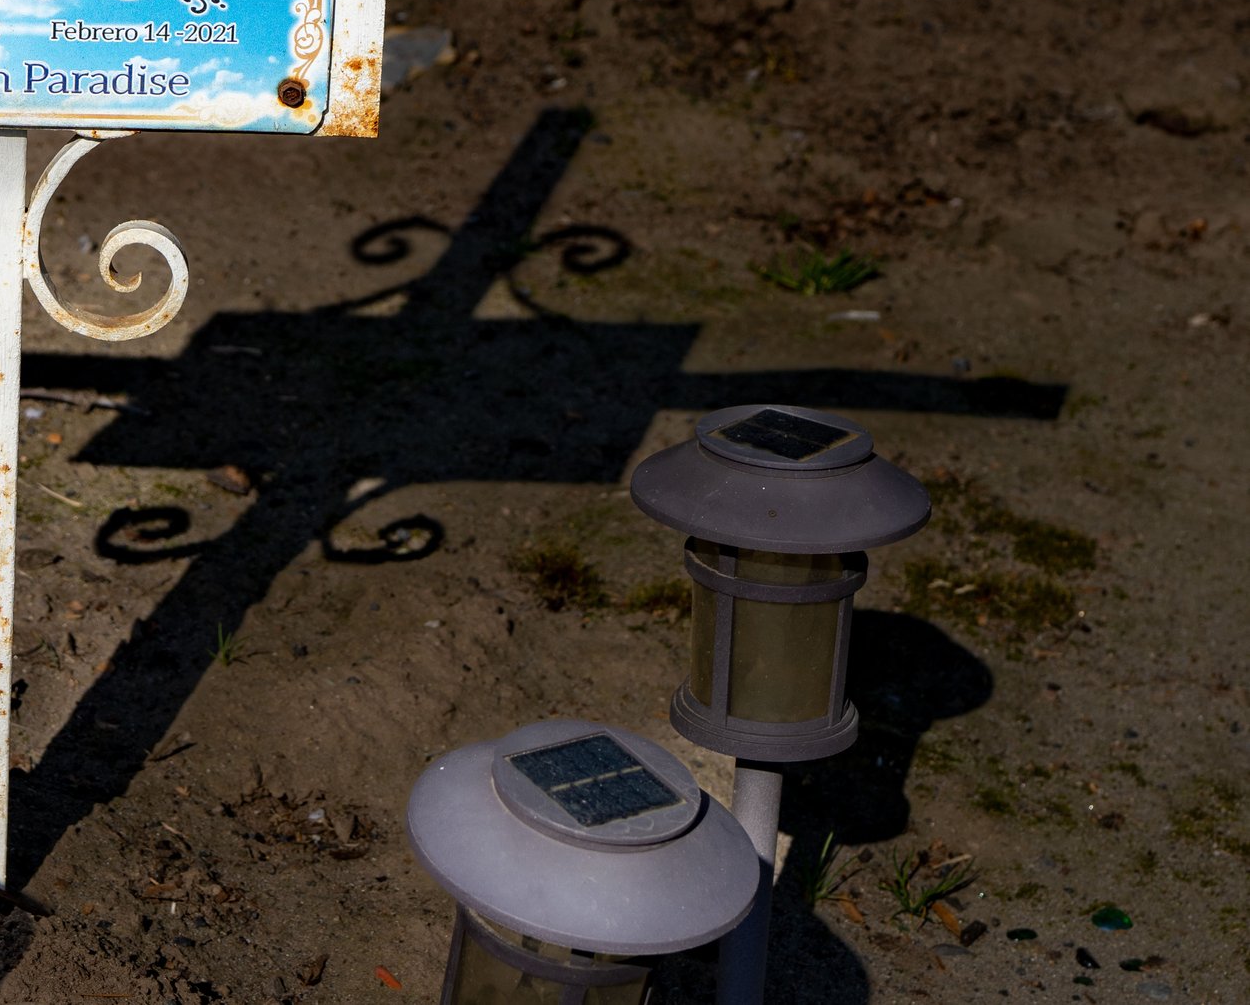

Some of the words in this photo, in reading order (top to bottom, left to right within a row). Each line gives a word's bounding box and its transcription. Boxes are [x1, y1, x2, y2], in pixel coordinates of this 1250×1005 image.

[51, 21, 138, 41] Febrero
[144, 23, 171, 42] 14
[23, 62, 190, 95] Paradise
